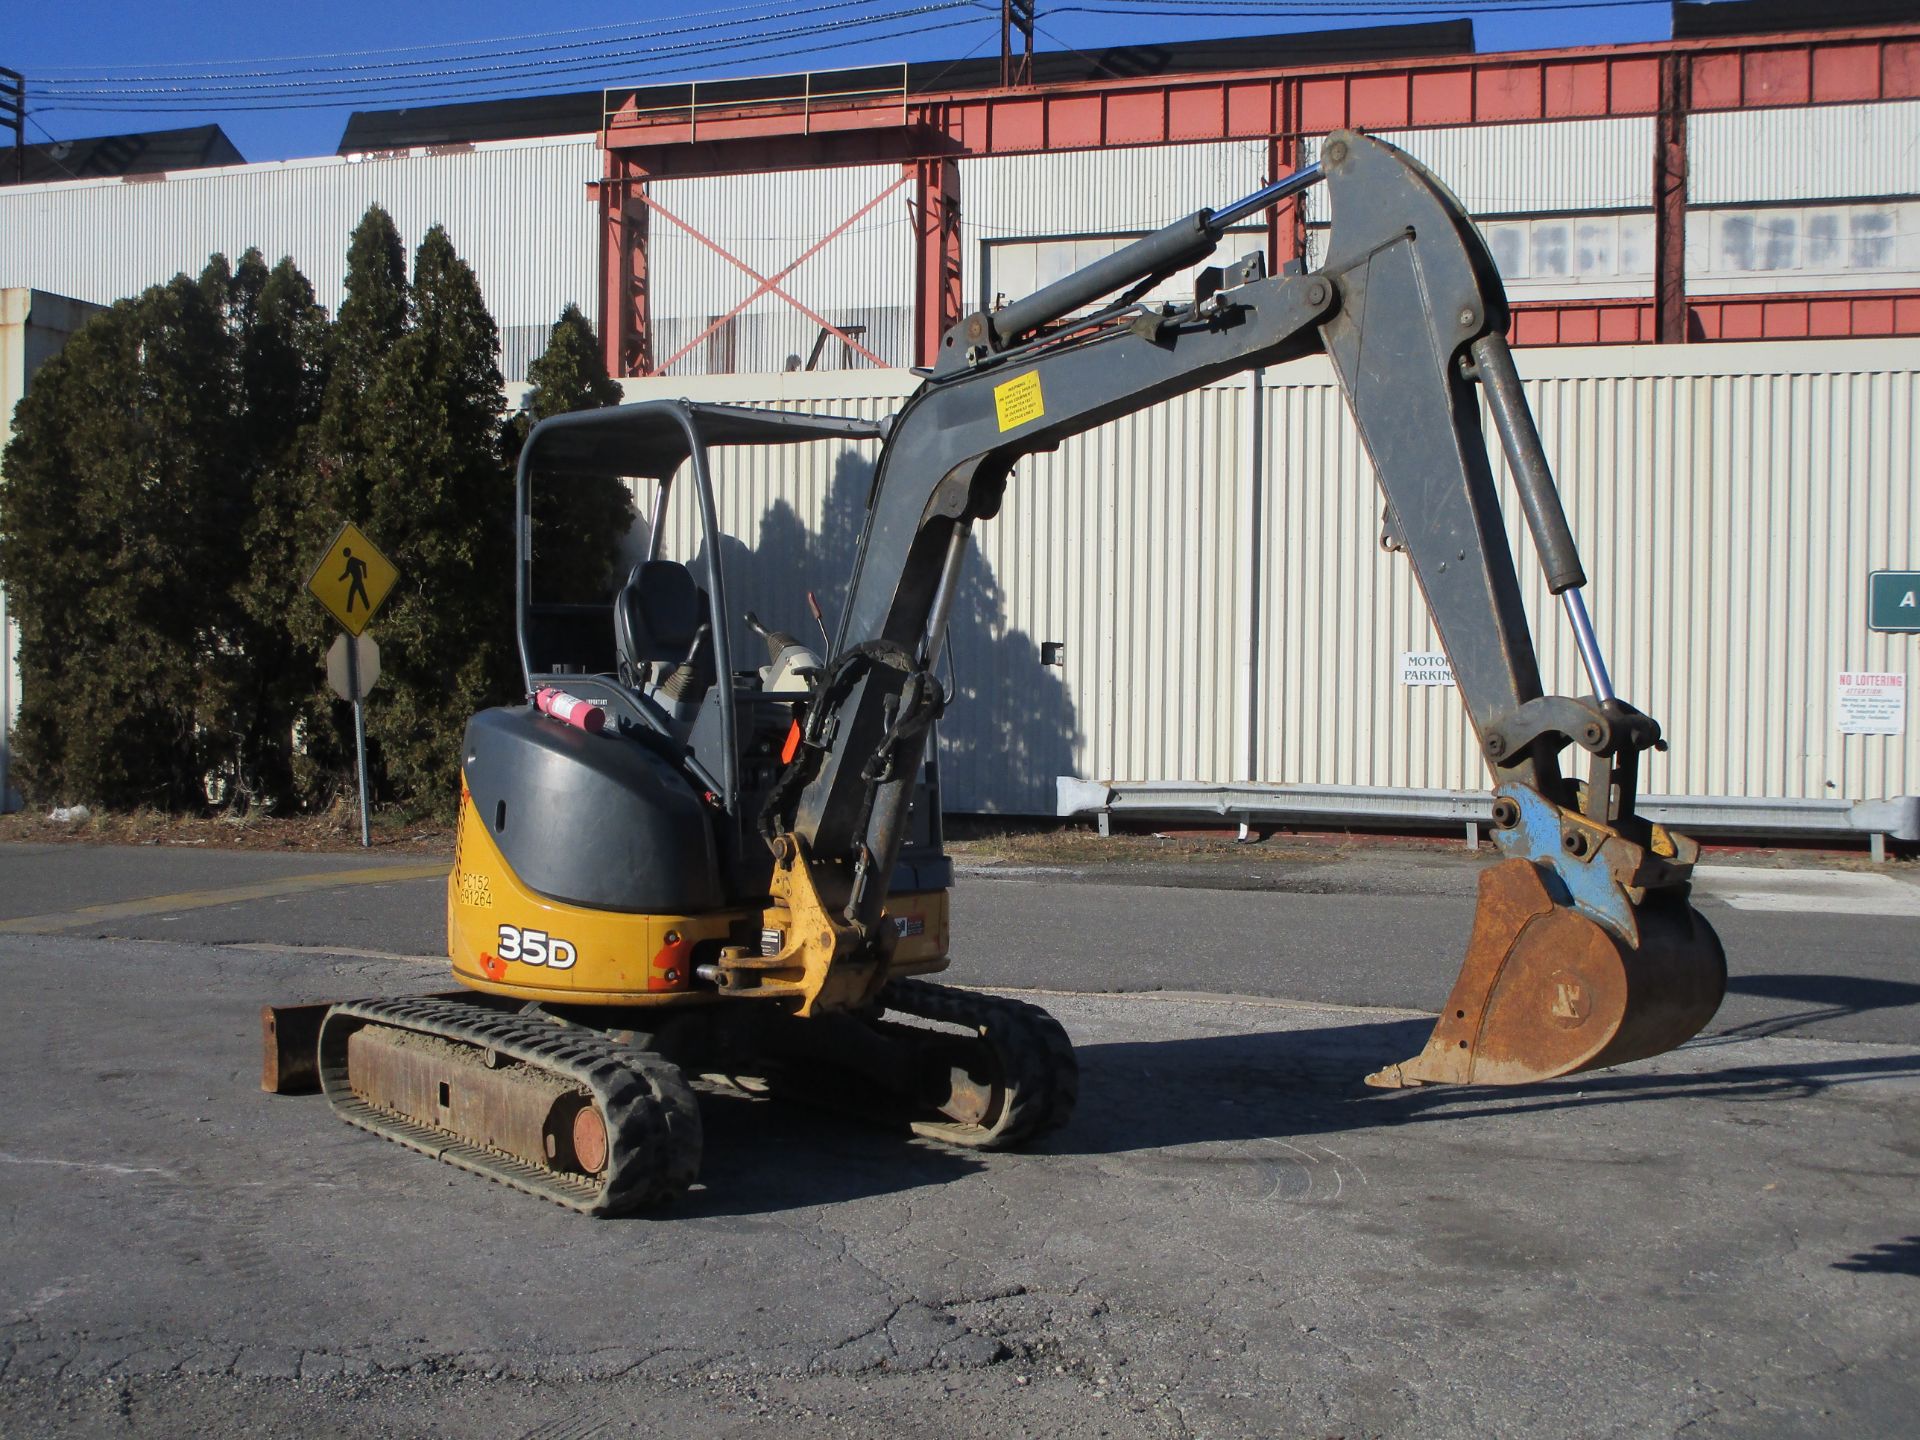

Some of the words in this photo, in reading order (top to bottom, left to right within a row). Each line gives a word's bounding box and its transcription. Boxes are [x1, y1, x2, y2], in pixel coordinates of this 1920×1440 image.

[1839, 674, 1852, 686] NO
[1856, 675, 1902, 687] LOITERING
[464, 872, 490, 891] PC152
[498, 923, 577, 970] 35D
